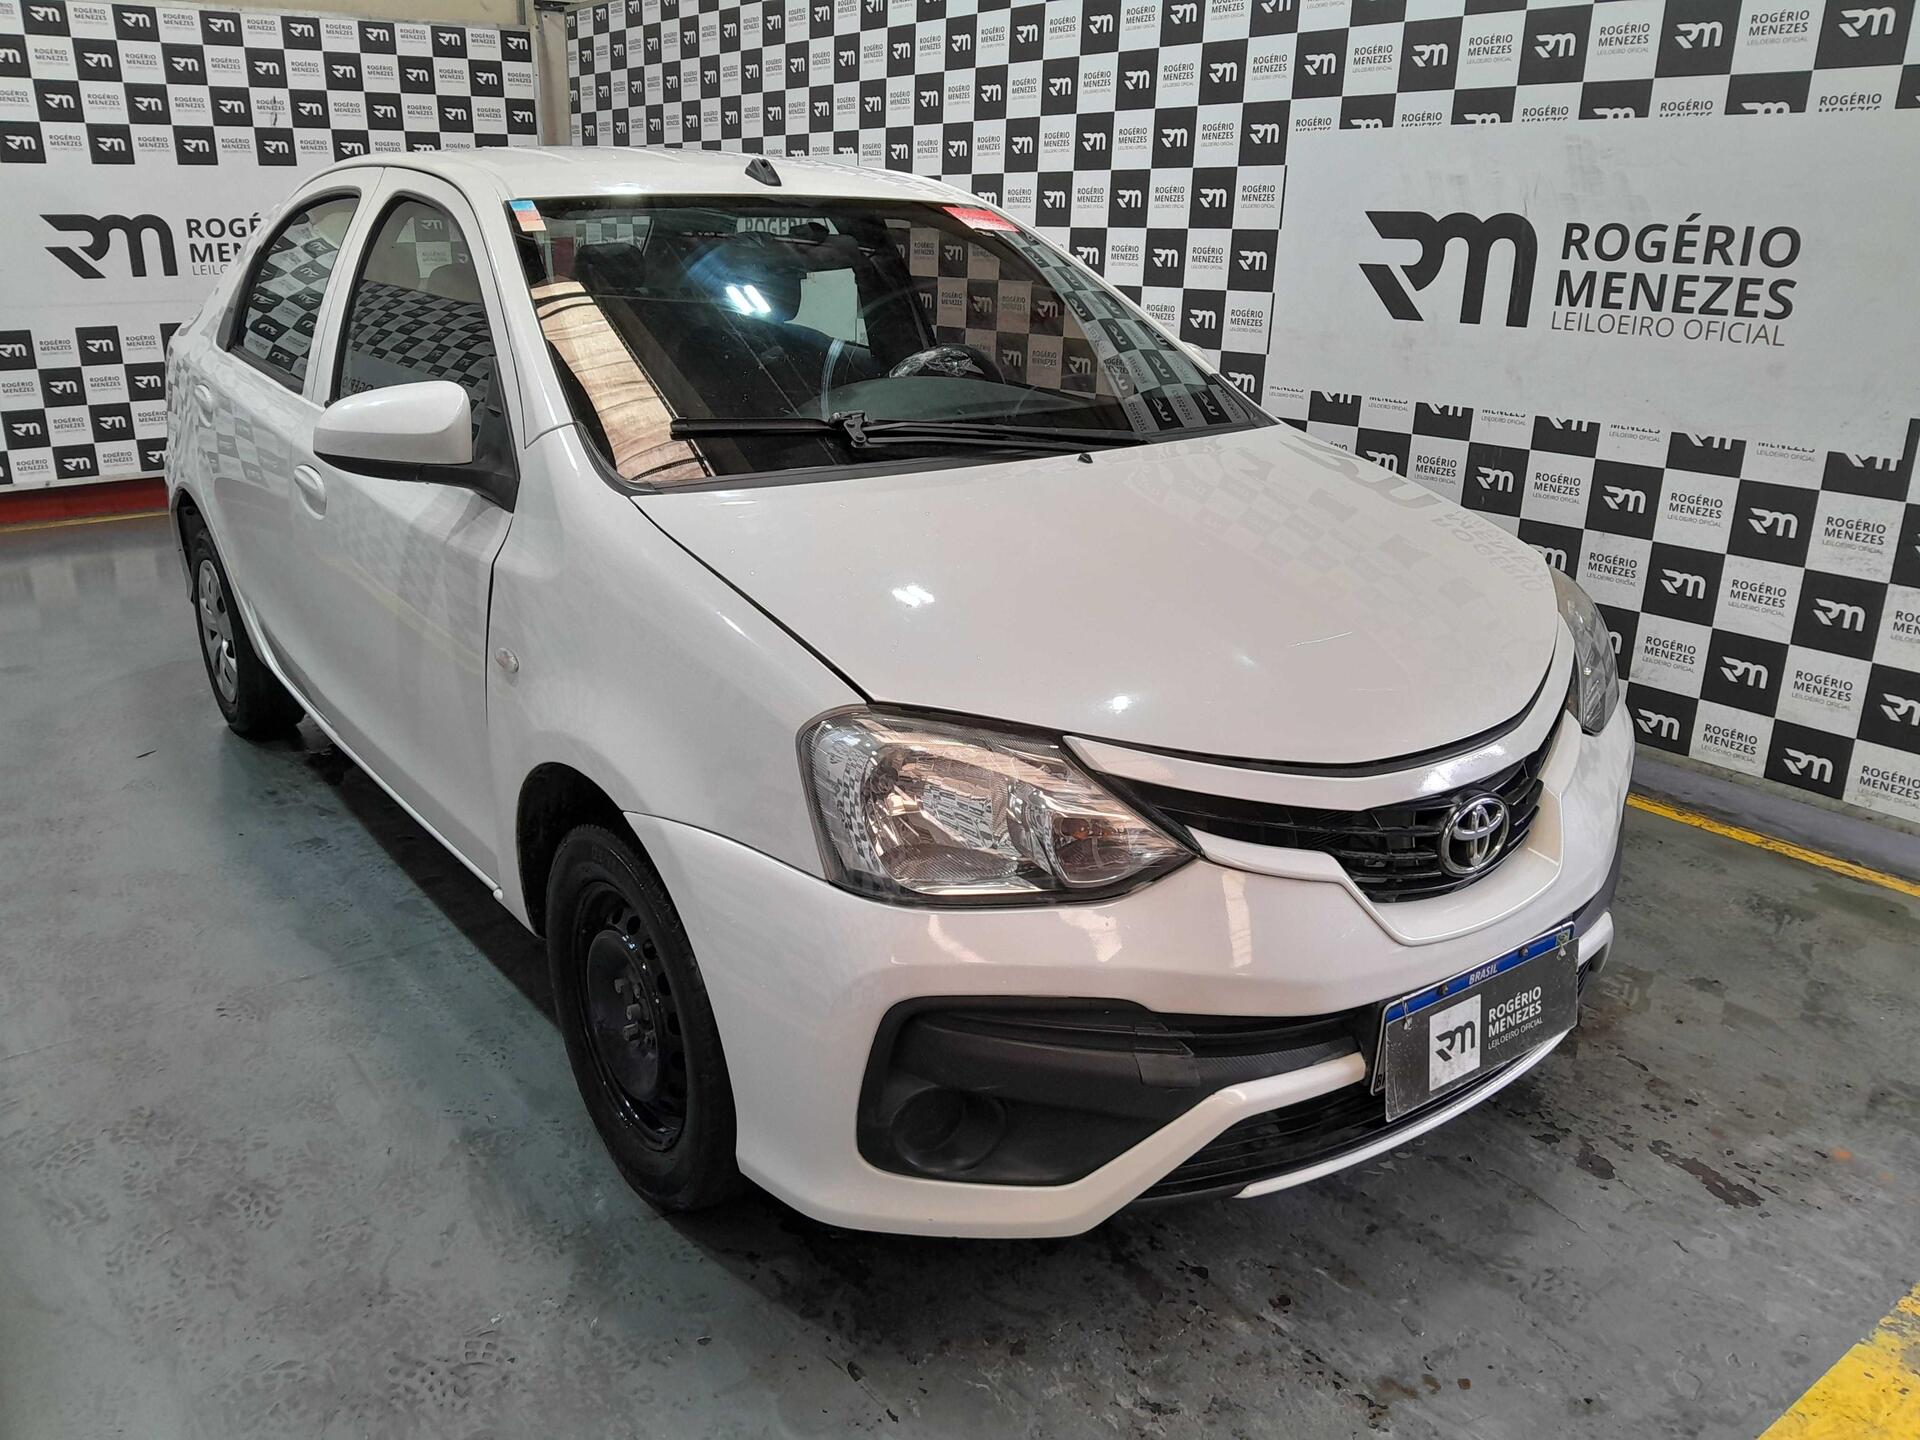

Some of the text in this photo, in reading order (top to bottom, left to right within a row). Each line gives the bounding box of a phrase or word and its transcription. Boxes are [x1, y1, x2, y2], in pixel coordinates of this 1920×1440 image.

[1126, 5, 1155, 15] ROGÉRIO
[1750, 9, 1810, 23] ROGÉRIO
[1126, 13, 1155, 24] MENEZES
[1600, 22, 1651, 35] ROGÉRIO
[1748, 22, 1807, 35] MENEZES
[1468, 33, 1513, 46] ROGÉRIO
[1598, 34, 1649, 46] MENEZES
[1354, 44, 1393, 55] ROGÉRIO
[1467, 44, 1511, 56] MENEZES
[1253, 53, 1287, 64] ROGÉRIO
[1353, 54, 1392, 65] MENEZES
[1163, 62, 1194, 72] ROGÉRIO
[1252, 63, 1286, 73] MENEZES
[1163, 71, 1193, 81] MENEZES
[1659, 99, 1713, 111] ROGÉRIO
[1819, 92, 1882, 105] ROGÉRIO
[1401, 111, 1442, 121] ROGÉRIO
[1522, 105, 1568, 116] ROGÉRIO
[1202, 121, 1233, 131] ROGÉRIO
[1295, 116, 1331, 126] ROGÉRIO
[1118, 126, 1147, 135] ROGÉRIO
[1201, 131, 1233, 140] MENEZES
[1118, 135, 1146, 143] MENEZES
[1077, 186, 1103, 194] ROGÉRIO
[1155, 185, 1184, 193] ROGÉRIO
[1242, 183, 1275, 192] ROGÉRIO
[186, 212, 261, 238] ROGÉ
[1561, 213, 1801, 268] ROGÉRIO
[1111, 243, 1138, 252] ROGÉRIO
[1192, 245, 1223, 254] ROGÉRIO
[1191, 255, 1222, 263] MENEZES
[1554, 269, 1797, 320] MENEZES
[1230, 308, 1263, 317] ROGÉRIO
[1230, 317, 1262, 326] MENEZES
[1550, 310, 1785, 347] LEILOEIRO OFICIAL
[1416, 455, 1456, 467] ROGÉRIO
[1415, 464, 1455, 477] MENEZES
[1535, 472, 1580, 486] ROGÉRIO
[1533, 481, 1579, 496] MENEZES
[1670, 492, 1723, 507] ROGÉRIO
[1668, 502, 1721, 518] MENEZES
[1825, 516, 1886, 533] ROGÉRIO
[1823, 527, 1884, 544] MENEZES
[1589, 552, 1637, 568] ROGÉRIO
[1587, 561, 1635, 578] MENEZES
[1731, 579, 1786, 596] ROGÉRIO
[1729, 589, 1784, 607] MENEZES
[1645, 635, 1696, 654] ROGÉRIO
[1643, 645, 1694, 664] MENEZES
[1795, 669, 1853, 690] ROGÉRIO
[1793, 680, 1851, 701] MENEZES
[1704, 723, 1757, 744] ROGÉRIO
[1702, 733, 1755, 754] MENEZES
[1861, 765, 1920, 788] ROGÉRIO
[1859, 775, 1920, 799] MENEZES
[1468, 964, 1498, 985] BRASIL
[1488, 986, 1542, 1023] ROGÉRIO
[1488, 1001, 1542, 1038] MENEZES
[1488, 1017, 1543, 1050] LEILOEIRO OFICIAL
